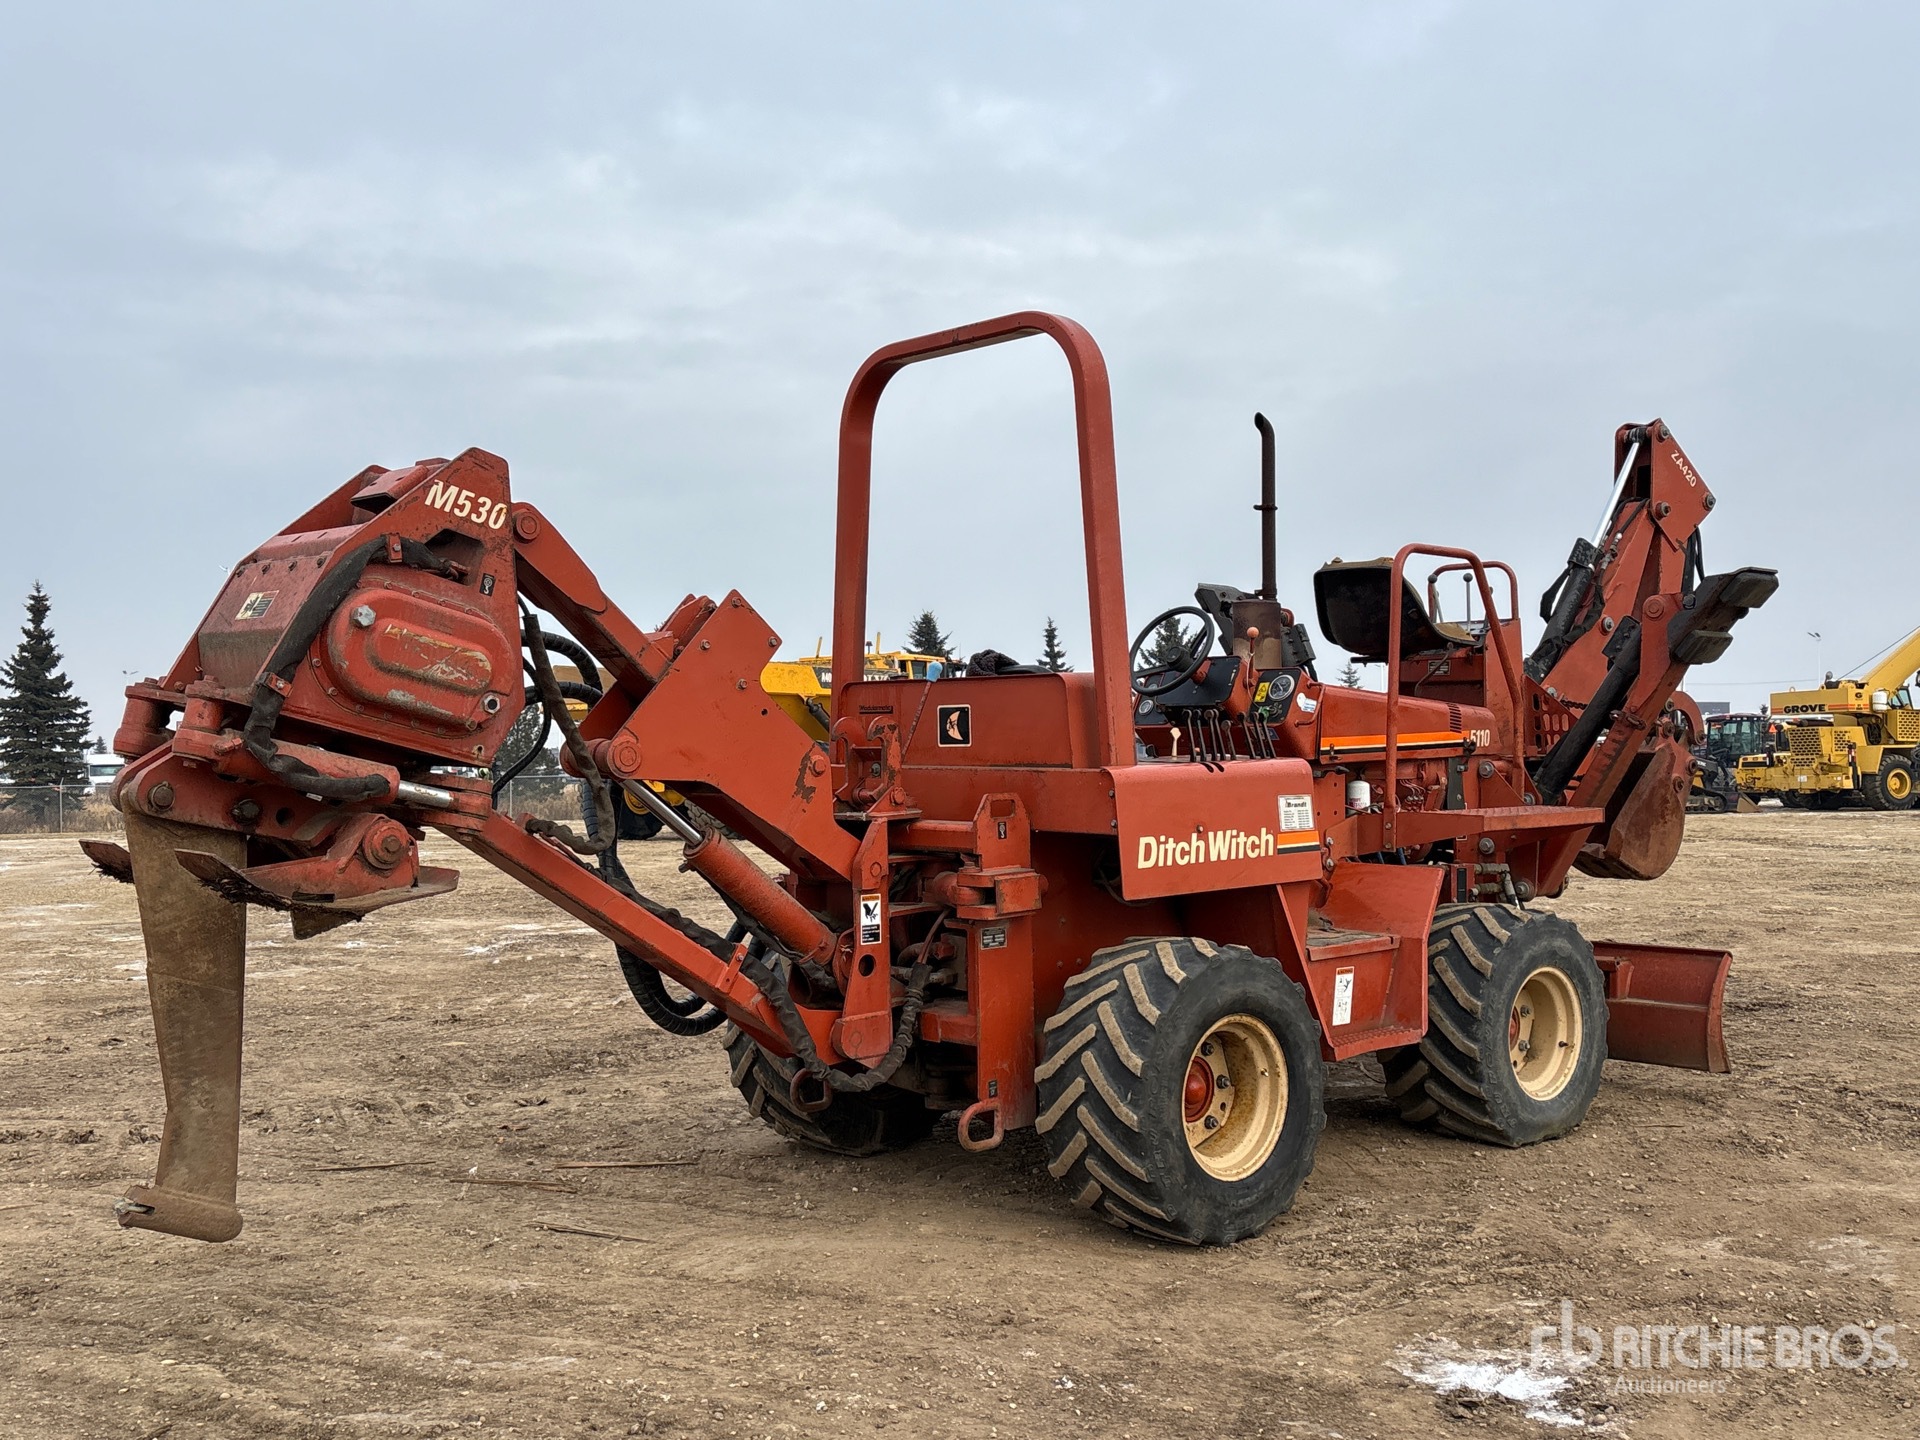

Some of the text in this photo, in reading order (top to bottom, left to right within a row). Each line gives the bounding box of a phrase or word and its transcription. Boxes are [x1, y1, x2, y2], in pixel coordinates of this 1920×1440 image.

[1671, 450, 1696, 487] ZA420
[424, 479, 508, 530] M530
[1783, 703, 1825, 714] GROVE
[1470, 729, 1490, 748] 5110
